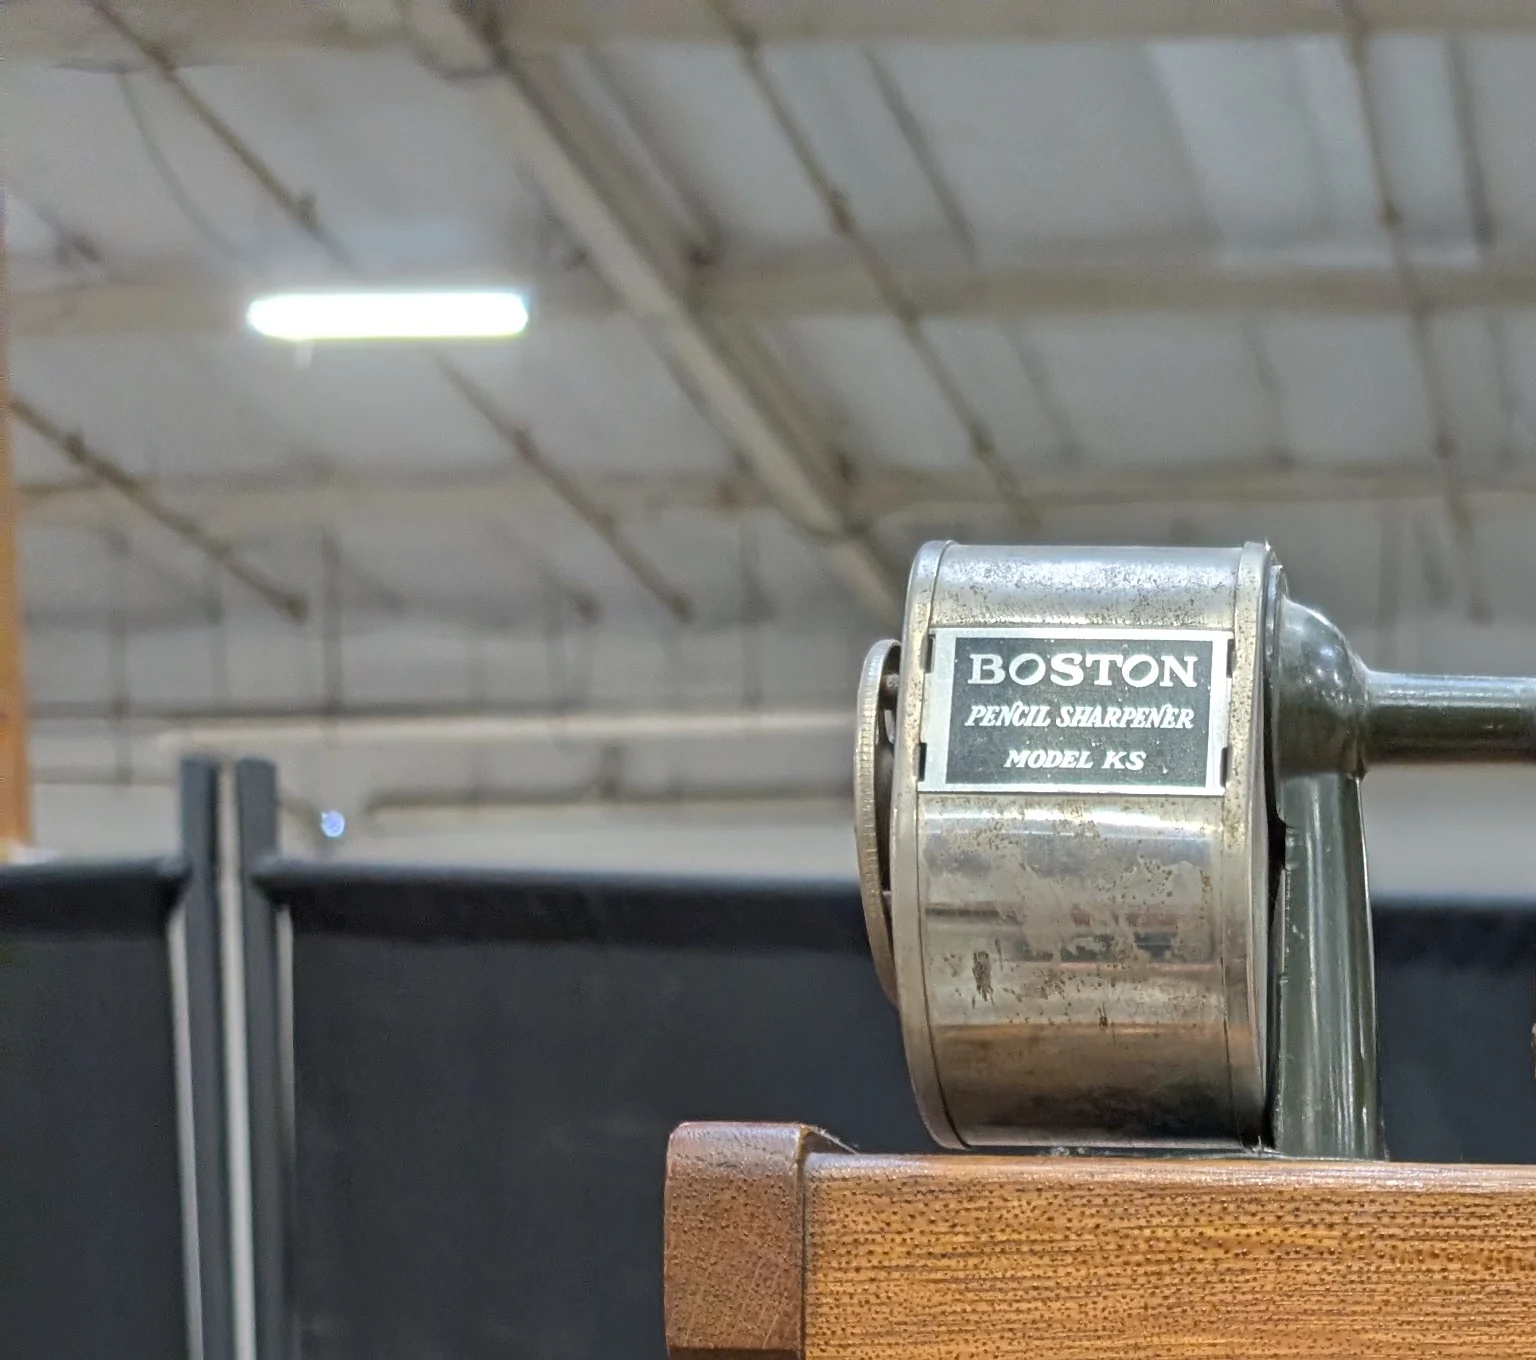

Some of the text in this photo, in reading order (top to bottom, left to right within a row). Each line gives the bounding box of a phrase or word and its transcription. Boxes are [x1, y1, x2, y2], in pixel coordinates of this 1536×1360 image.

[967, 653, 1198, 688] BOSTON
[964, 700, 1195, 729] PENCIL SHARPENER
[1003, 748, 1147, 771] MODEL KS
